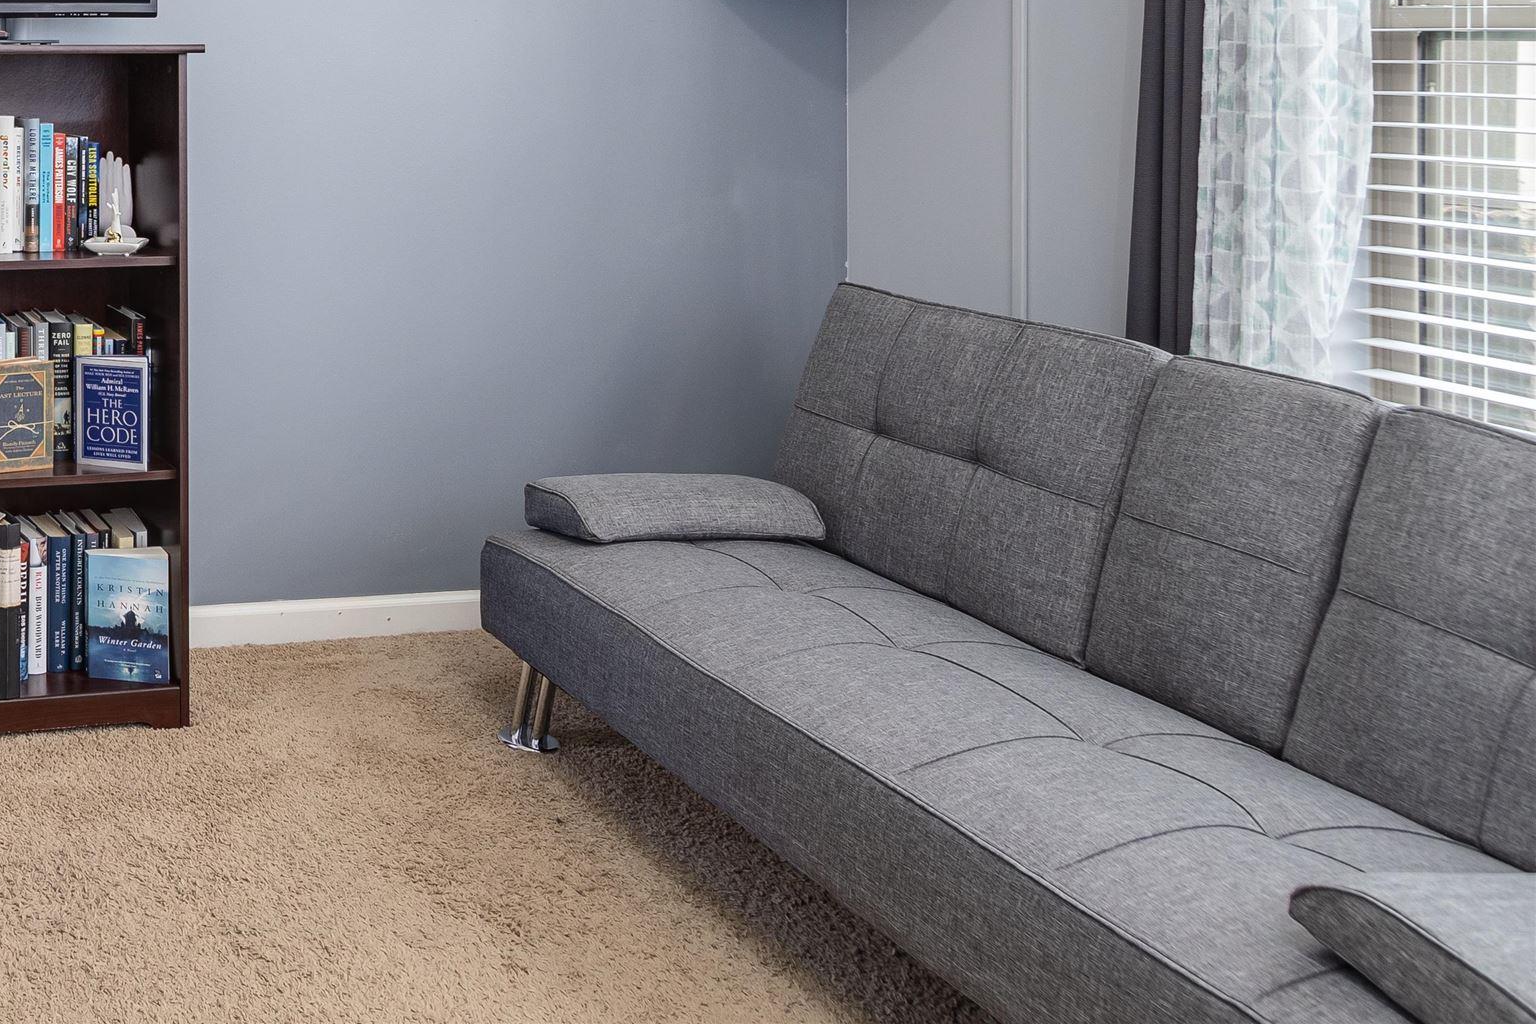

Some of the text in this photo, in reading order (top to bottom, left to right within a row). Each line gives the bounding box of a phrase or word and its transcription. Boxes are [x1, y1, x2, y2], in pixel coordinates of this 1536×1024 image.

[29, 128, 37, 147] LOOK
[0, 135, 10, 189] generations
[29, 150, 37, 163] FOR
[54, 147, 63, 168] JAMES
[29, 166, 36, 176] ME
[88, 148, 97, 207] LISA SCOTTOLINE
[16, 176, 20, 187] ME
[54, 169, 63, 204] PATTERSON
[67, 159, 77, 203] CRY WOLF
[13, 390, 43, 398] LECTURE
[86, 383, 107, 391] William
[114, 385, 139, 393] McRaven
[102, 398, 123, 409] THE
[87, 408, 138, 427] HERO
[86, 425, 139, 445] CODE
[75, 576, 83, 606] COUNTS
[97, 583, 164, 597] KRISTIN
[97, 601, 164, 614] HANNAH
[98, 635, 162, 650] Winter Garden
